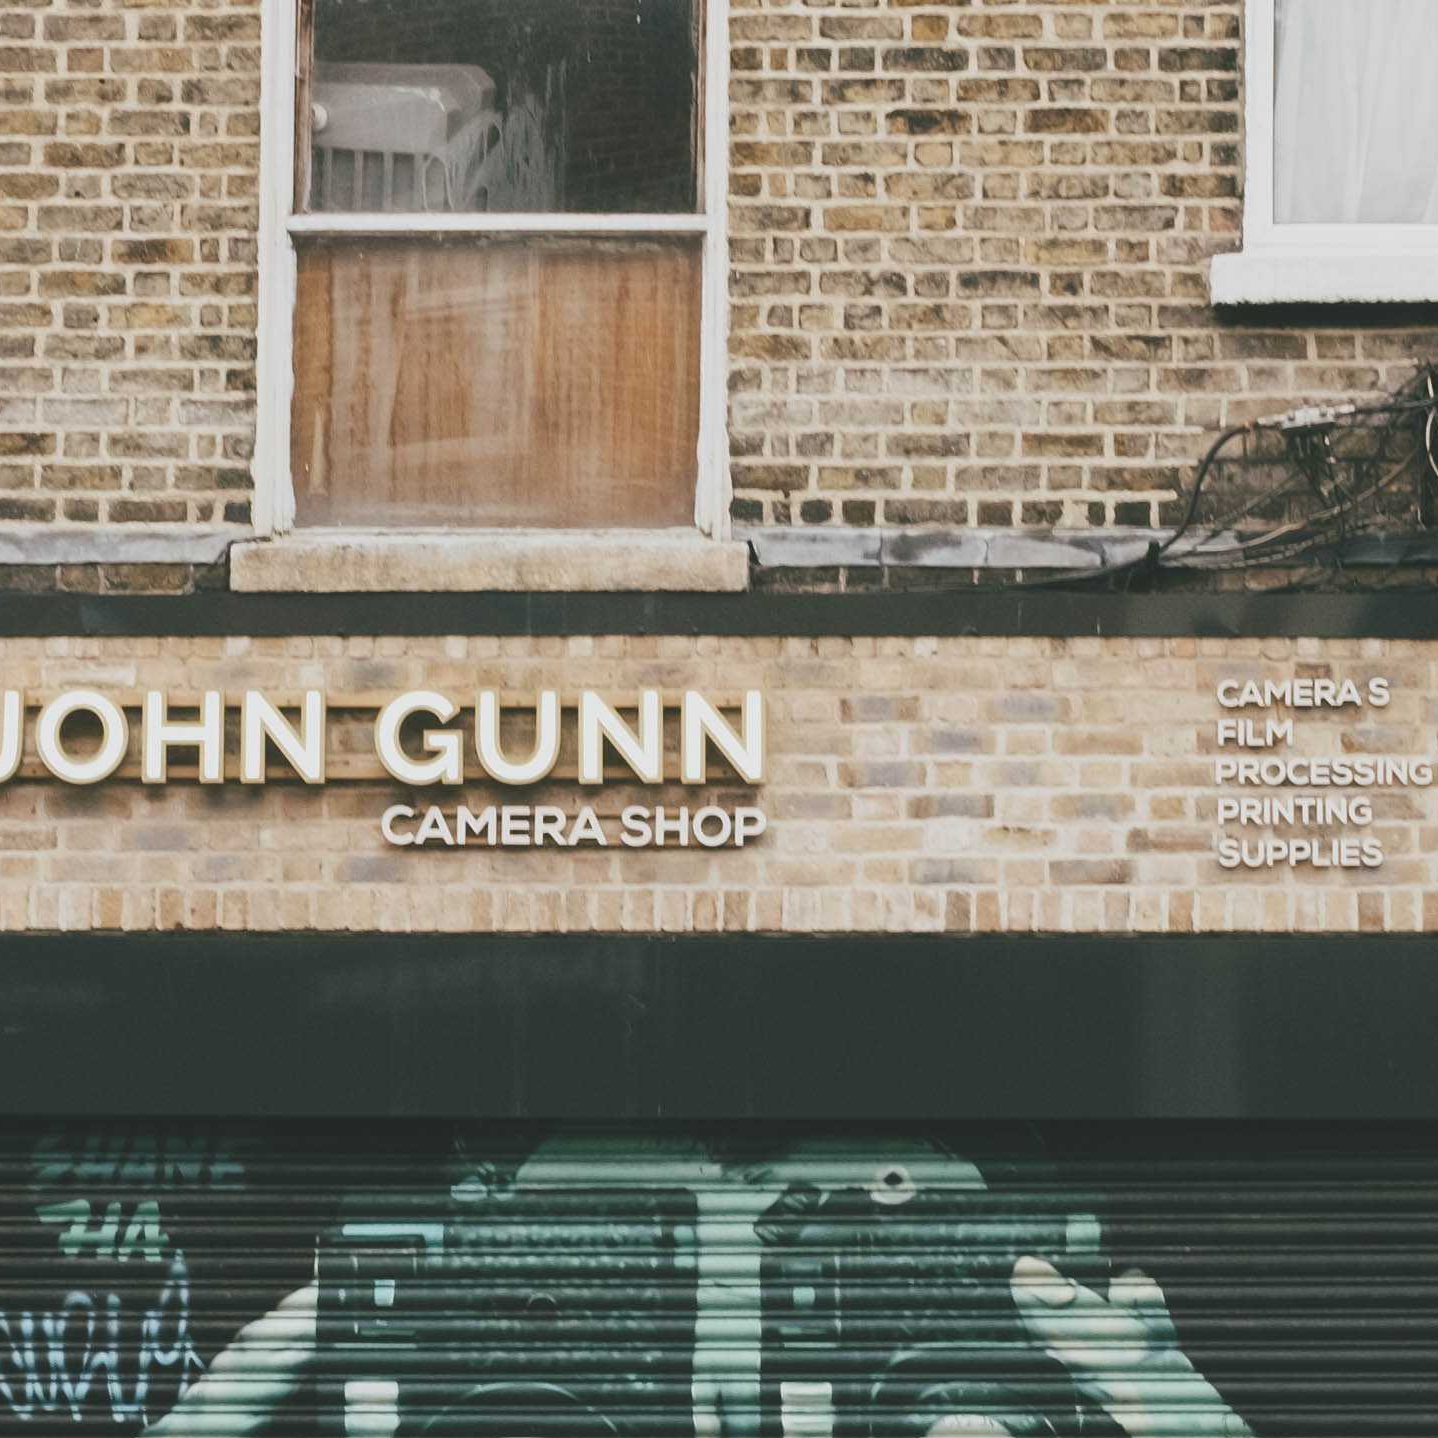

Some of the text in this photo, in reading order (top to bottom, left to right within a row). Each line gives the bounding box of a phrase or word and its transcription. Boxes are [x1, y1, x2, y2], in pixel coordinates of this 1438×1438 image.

[374, 689, 769, 785] GUNN
[1216, 719, 1294, 747] FILM
[1215, 758, 1434, 786] PROCESSING
[380, 804, 767, 847] CAMERA SHOP
[1217, 797, 1373, 826] PRINTING
[1217, 839, 1385, 868] SUPPLIES
